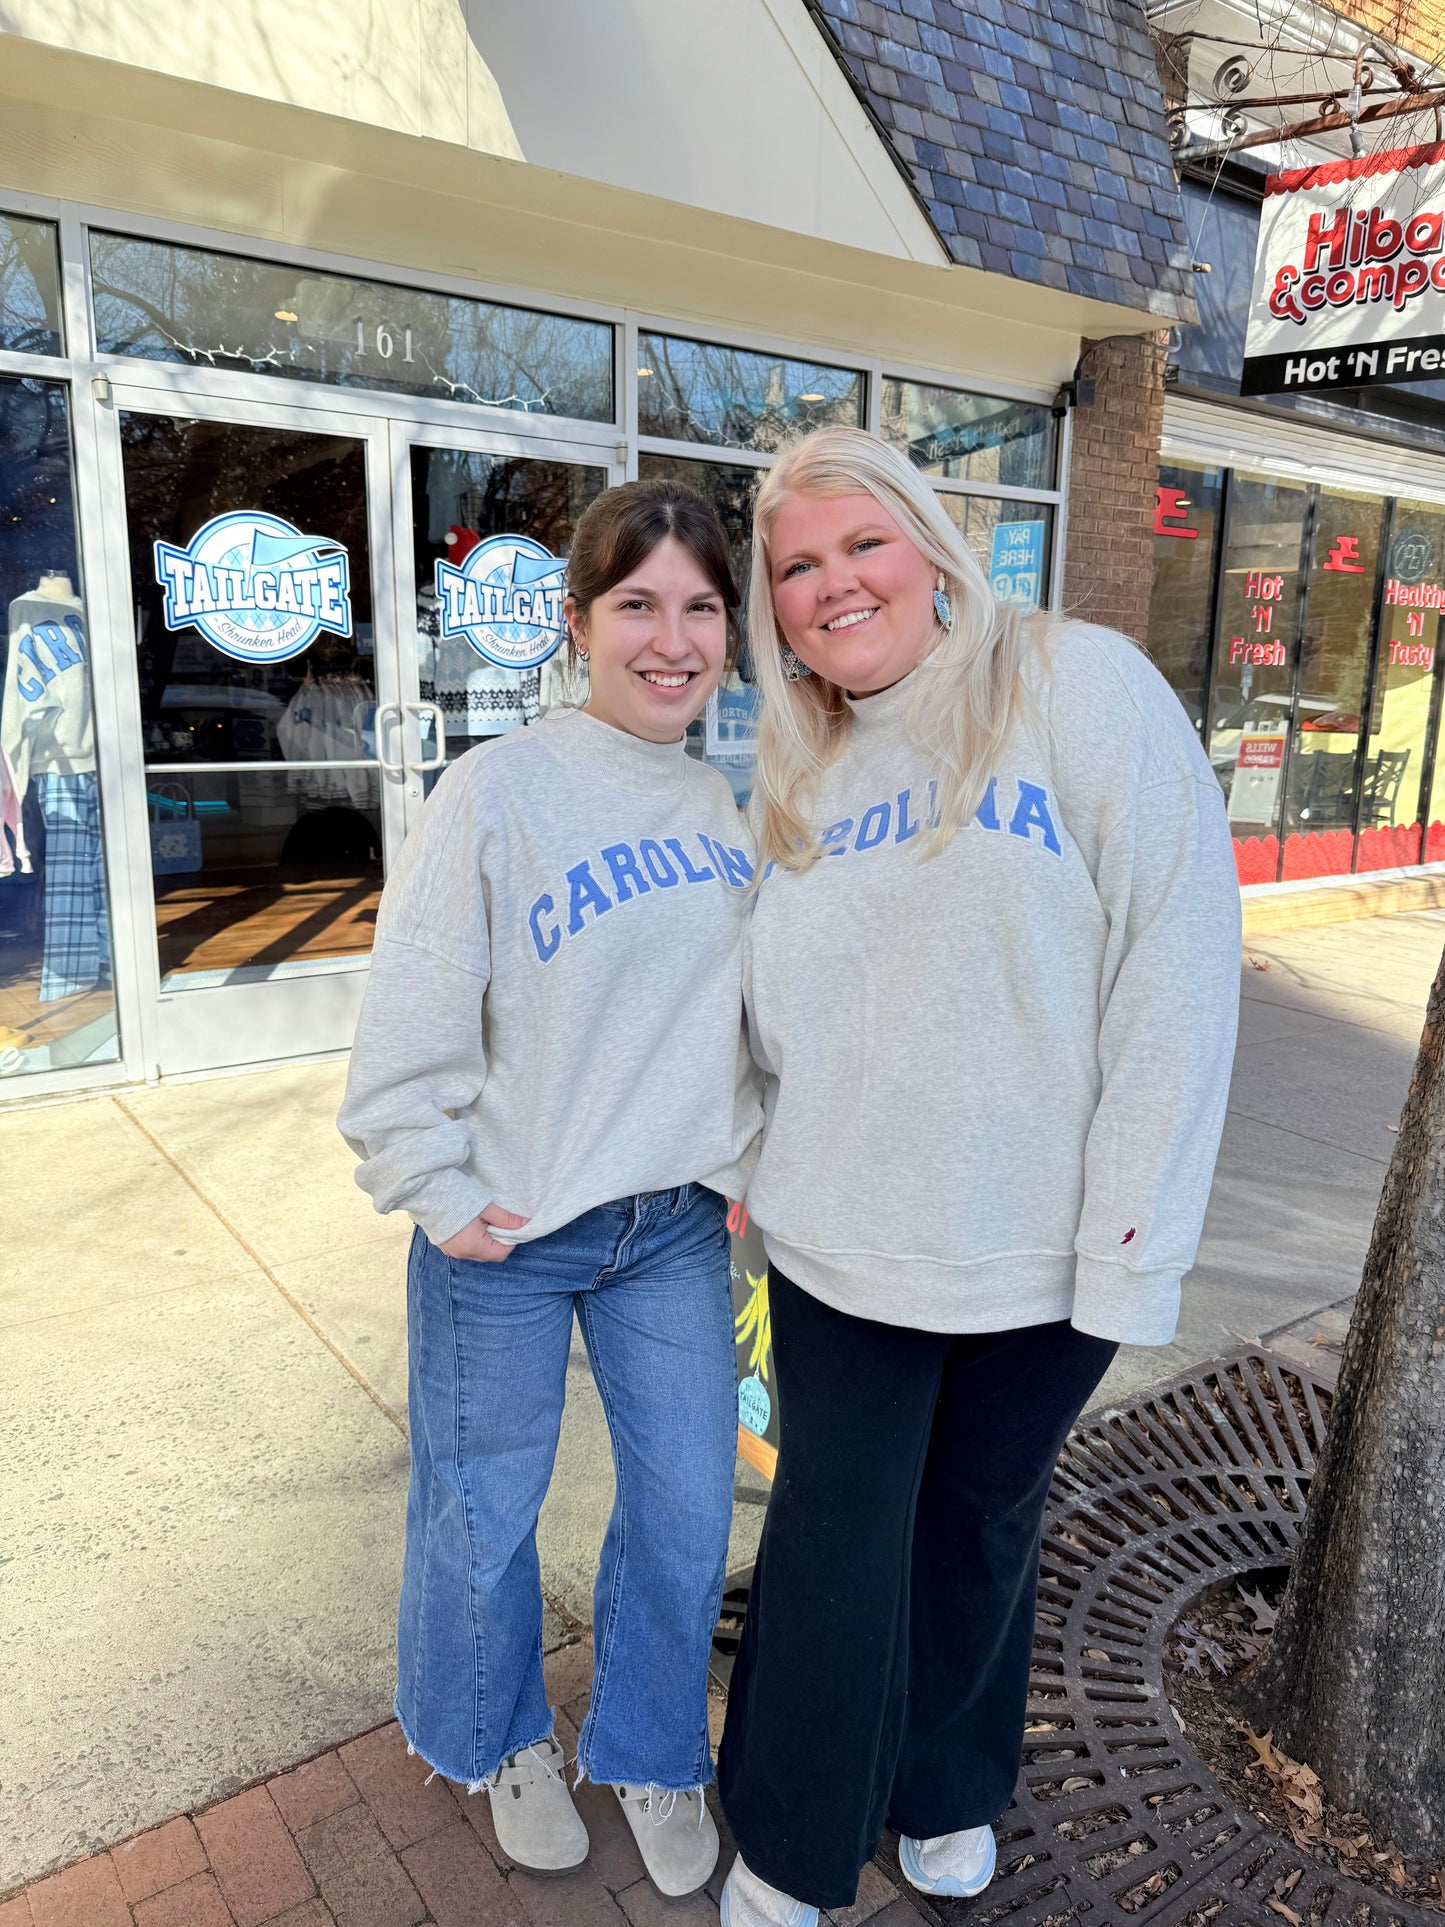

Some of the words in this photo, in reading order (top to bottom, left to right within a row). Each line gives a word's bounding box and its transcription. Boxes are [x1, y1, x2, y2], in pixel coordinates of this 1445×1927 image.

[1302, 206, 1445, 275] Hiba
[1268, 264, 1308, 325] &
[354, 315, 416, 364] 161
[1284, 356, 1341, 385] Hot
[164, 554, 346, 627] TAILGATE
[442, 570, 567, 633] TAILGAT
[1245, 570, 1284, 601] Hot
[217, 622, 275, 647] Shrunken
[277, 619, 304, 646] Head
[482, 633, 527, 658] Shrunken
[529, 632, 550, 655] Head
[1229, 637, 1286, 666] Fresh
[1388, 640, 1435, 672] Tasty
[527, 831, 757, 966] CAROLIN
